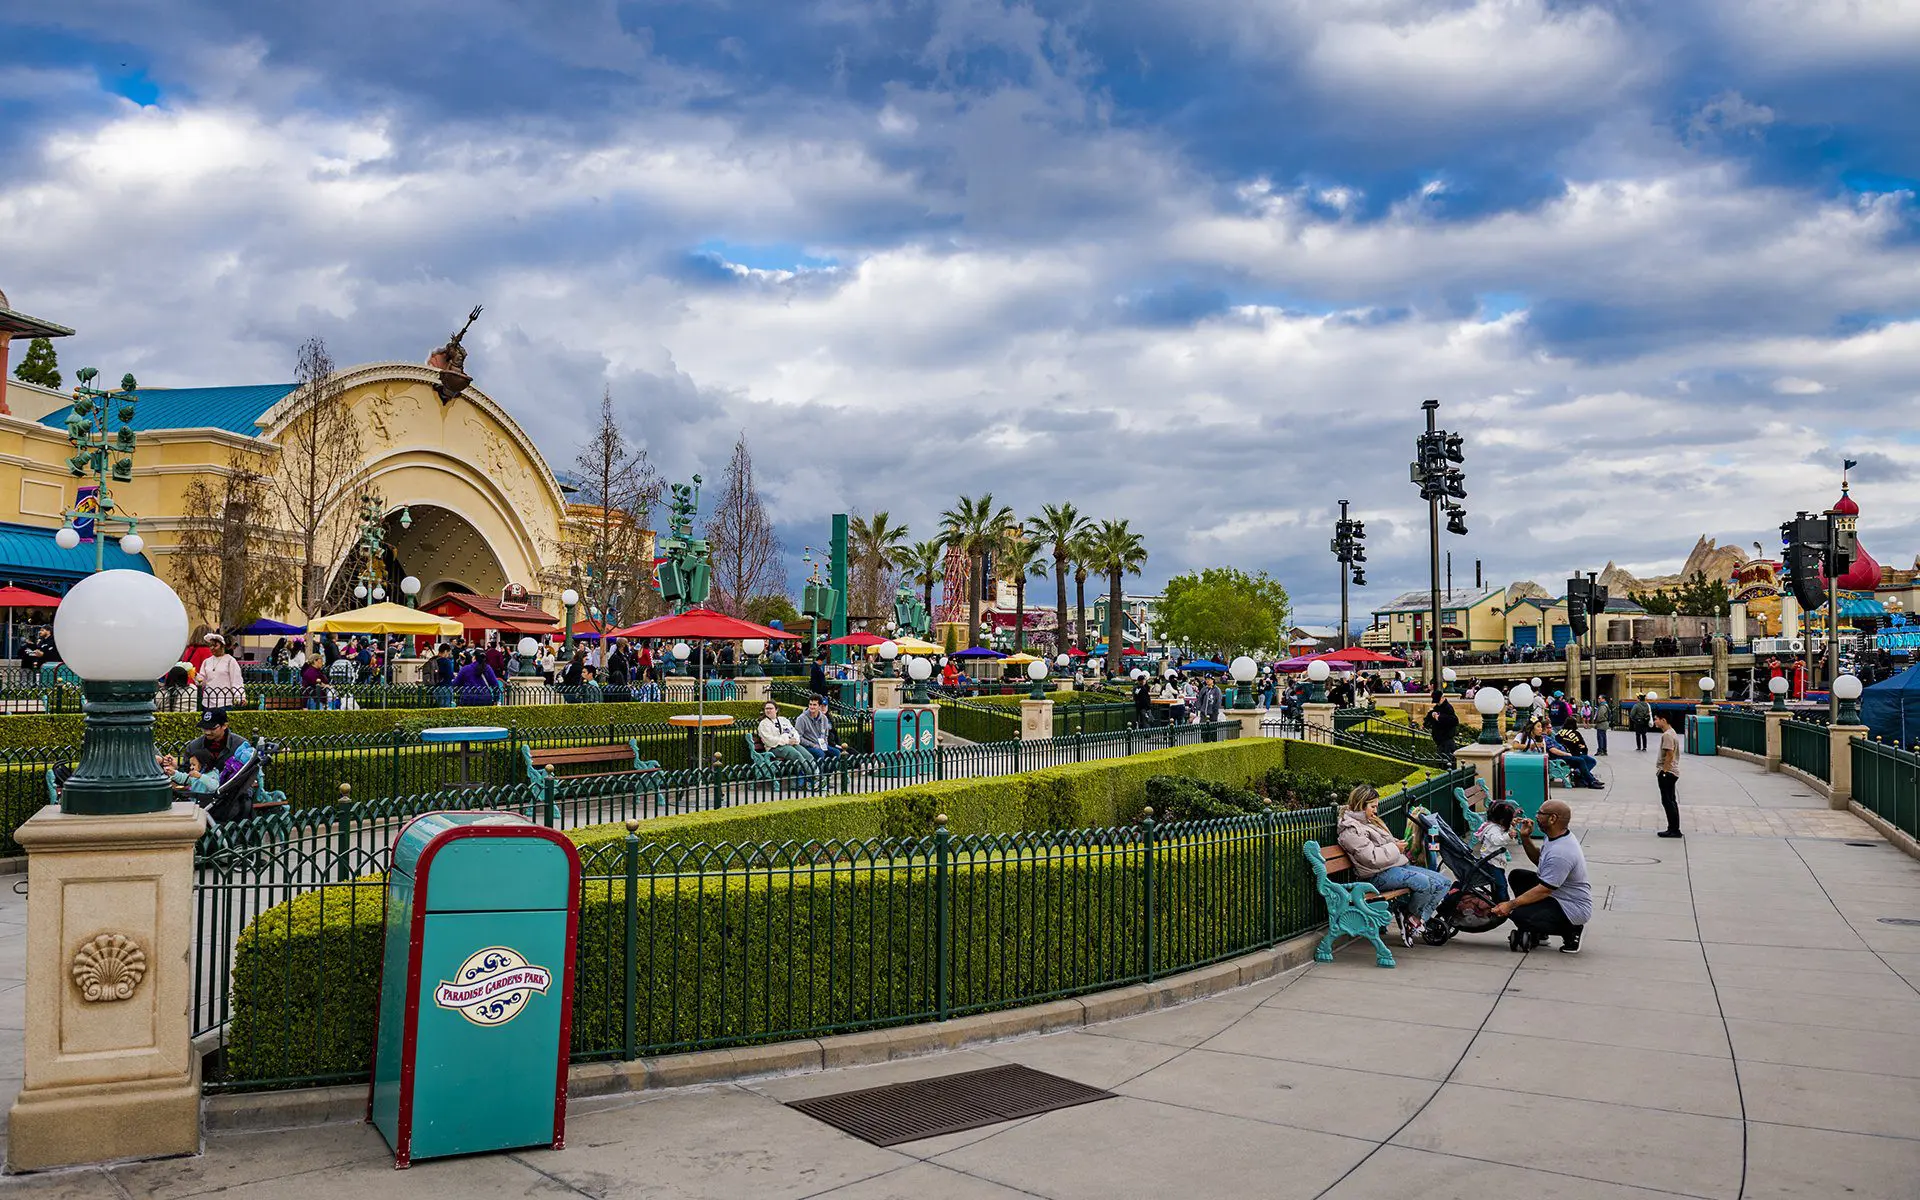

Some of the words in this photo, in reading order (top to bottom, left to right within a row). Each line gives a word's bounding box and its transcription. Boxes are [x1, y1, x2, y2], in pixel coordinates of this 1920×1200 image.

[443, 986, 484, 1001] PARADISE
[485, 973, 523, 995] GARDENS
[523, 972, 545, 985] PARK
